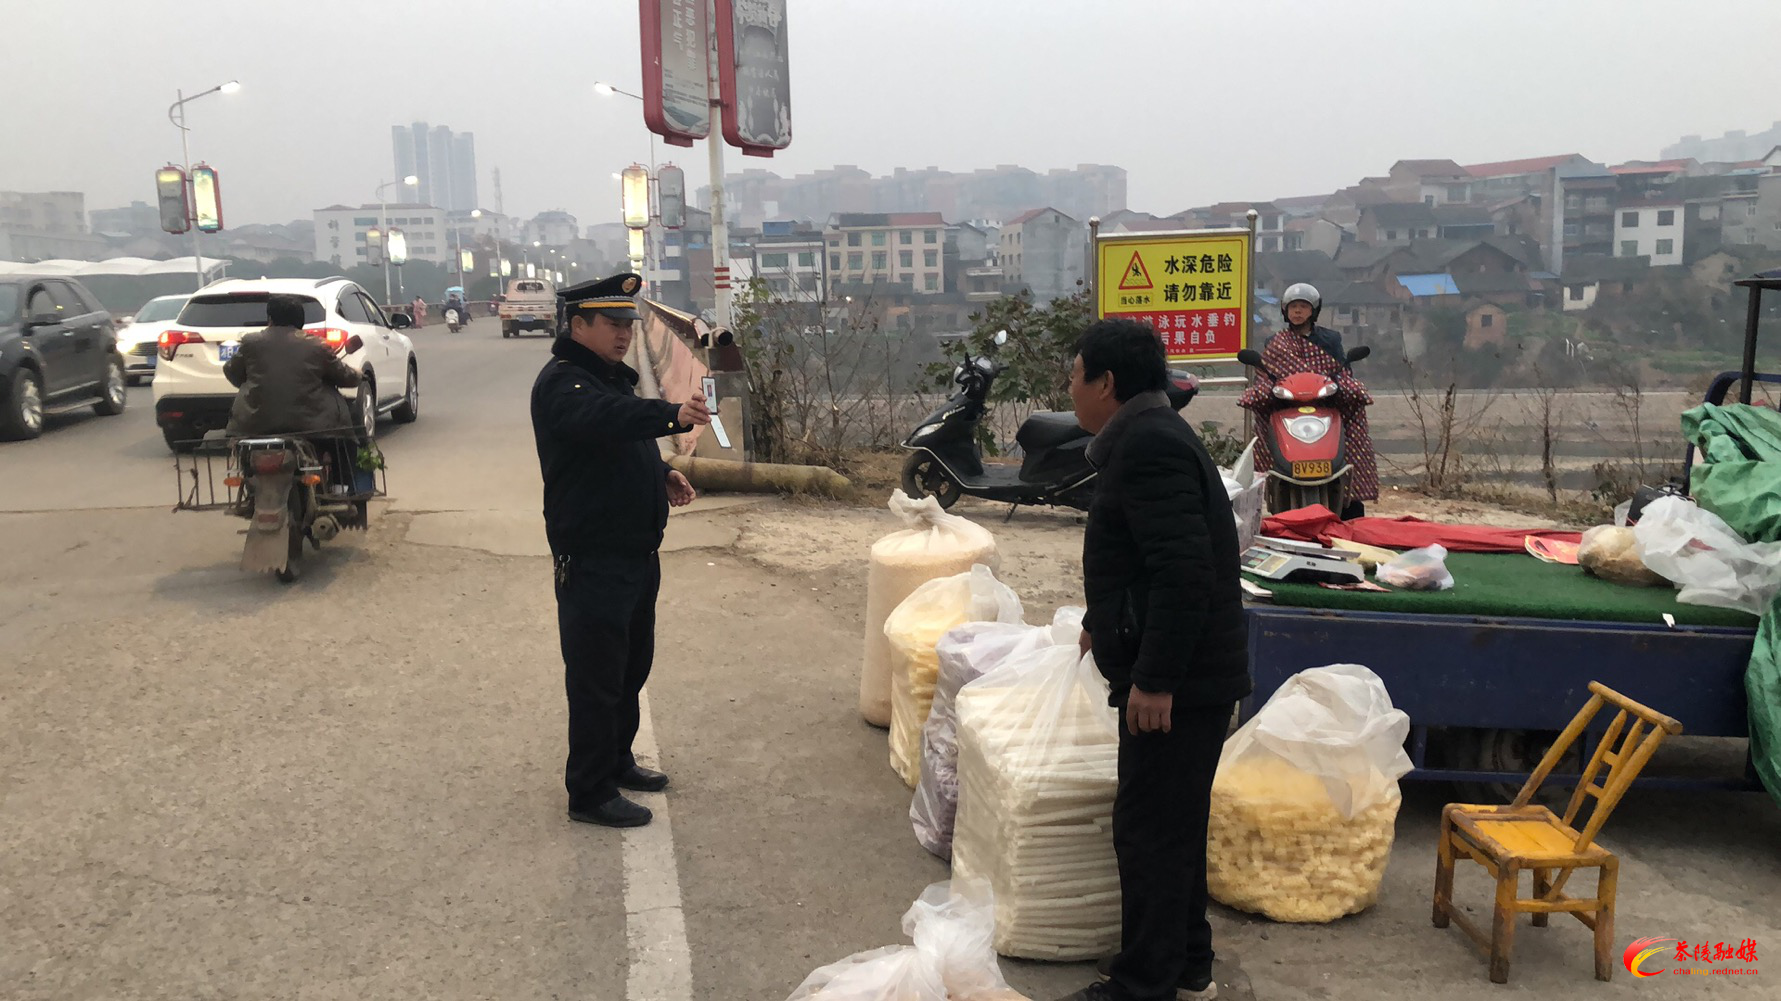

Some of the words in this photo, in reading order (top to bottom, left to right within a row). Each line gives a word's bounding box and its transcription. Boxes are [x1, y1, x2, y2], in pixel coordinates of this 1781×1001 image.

[1164, 253, 1233, 274] 水深危险
[1120, 295, 1151, 305] 当心落水
[1163, 282, 1232, 302] 请勿靠近
[1126, 312, 1236, 329] 游泳玩水垂钓
[1160, 330, 1216, 345] 后果自负
[1294, 462, 1330, 474] 8V938
